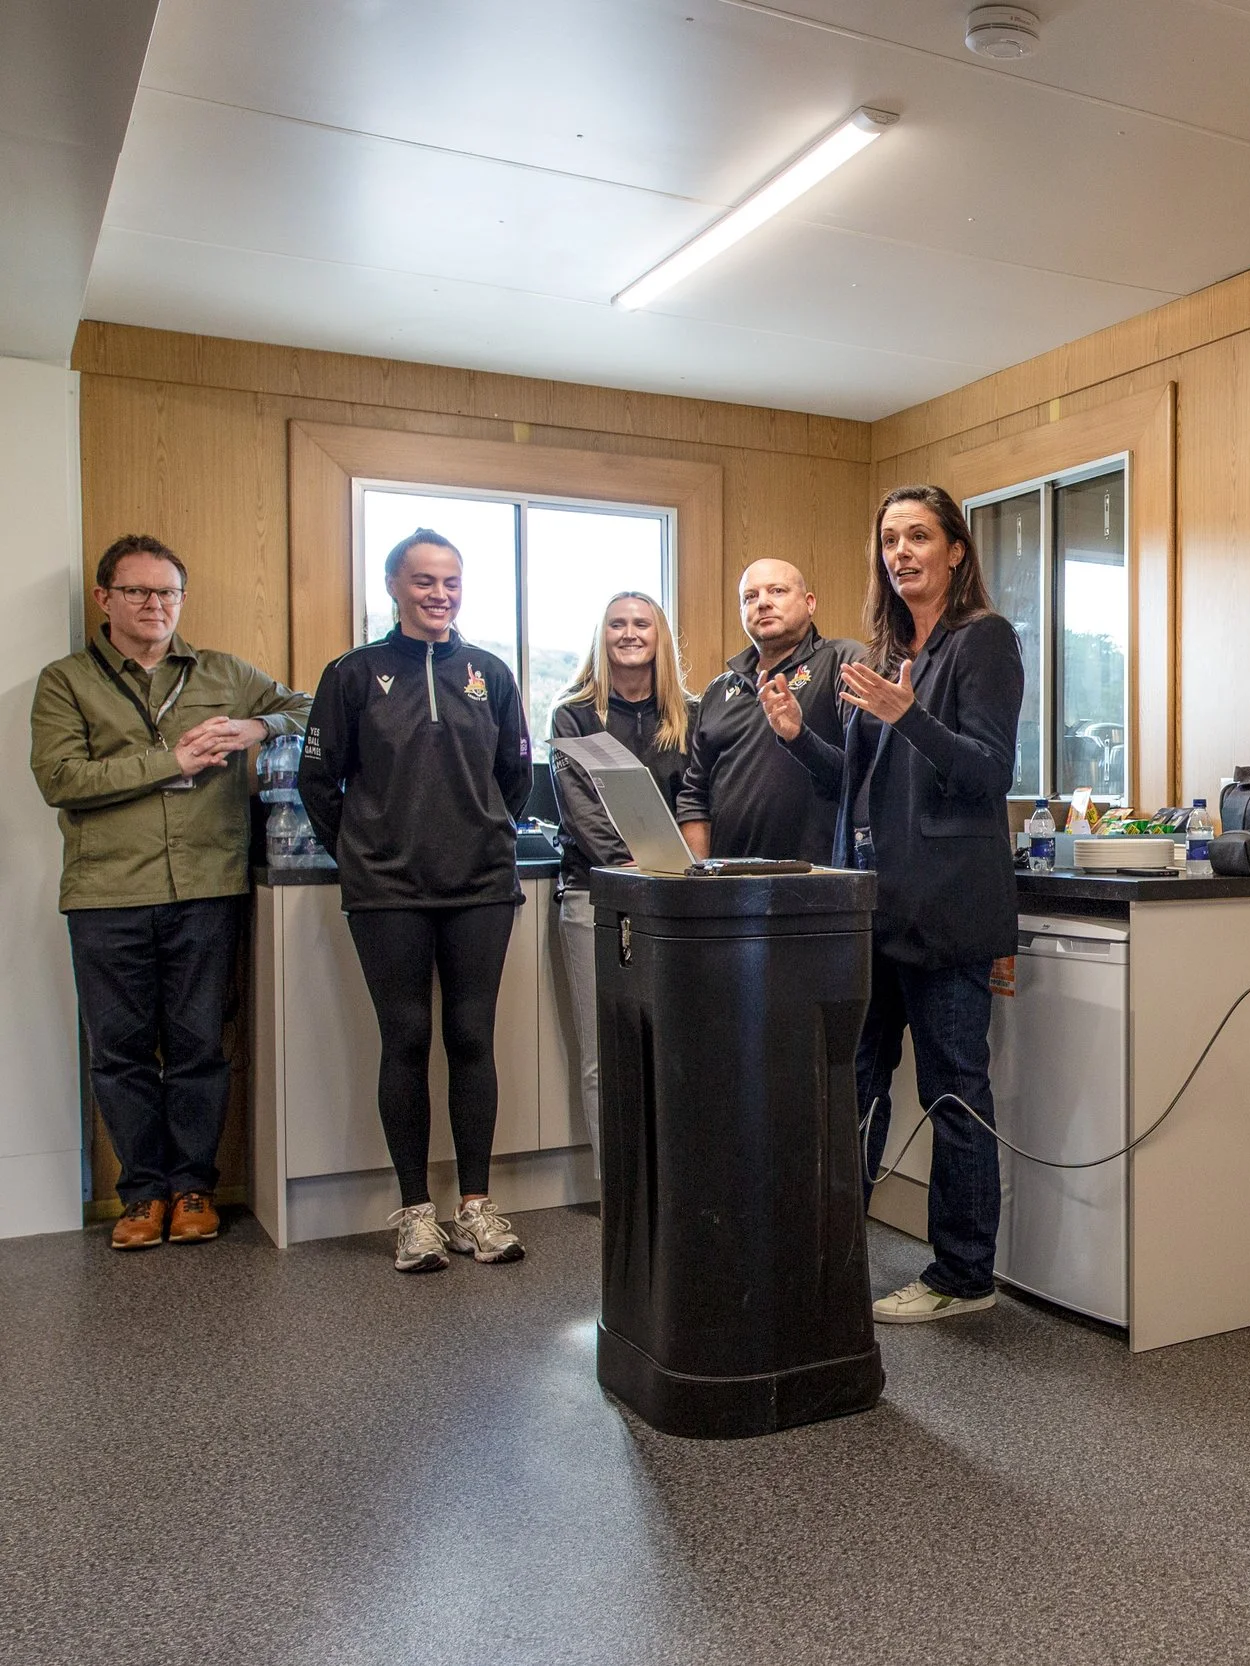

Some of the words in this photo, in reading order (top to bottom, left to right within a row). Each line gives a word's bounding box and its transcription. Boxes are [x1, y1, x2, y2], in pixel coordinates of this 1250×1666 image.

[310, 727, 320, 736] YES
[308, 736, 320, 746] BALL
[305, 745, 321, 756] GAMES
